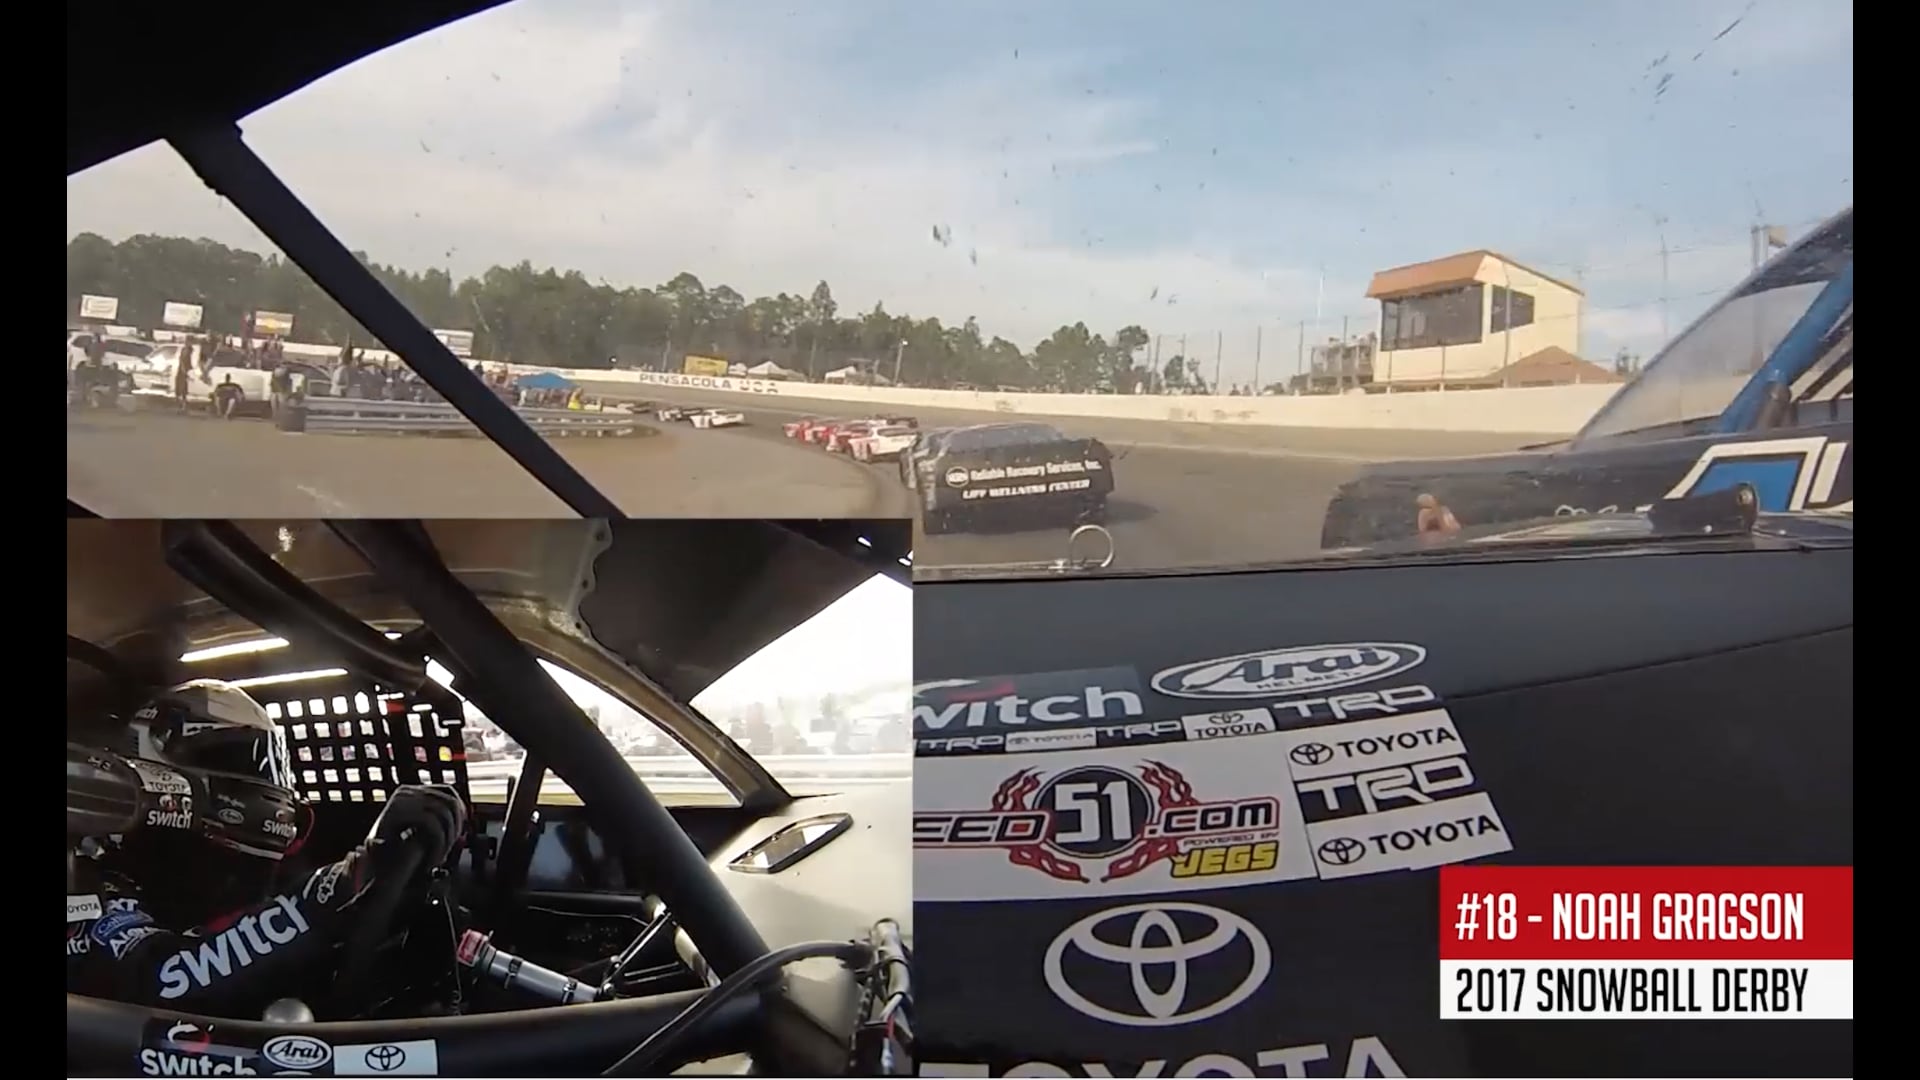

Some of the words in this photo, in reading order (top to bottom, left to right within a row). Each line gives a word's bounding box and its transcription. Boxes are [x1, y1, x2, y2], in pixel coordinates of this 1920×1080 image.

[639, 373, 732, 389] PENSACOLA
[1193, 722, 1269, 737] TOYOTA
[1337, 727, 1457, 758] TOYOTA
[1368, 815, 1500, 855] TOYOTA
[1171, 840, 1279, 878] JEGS
